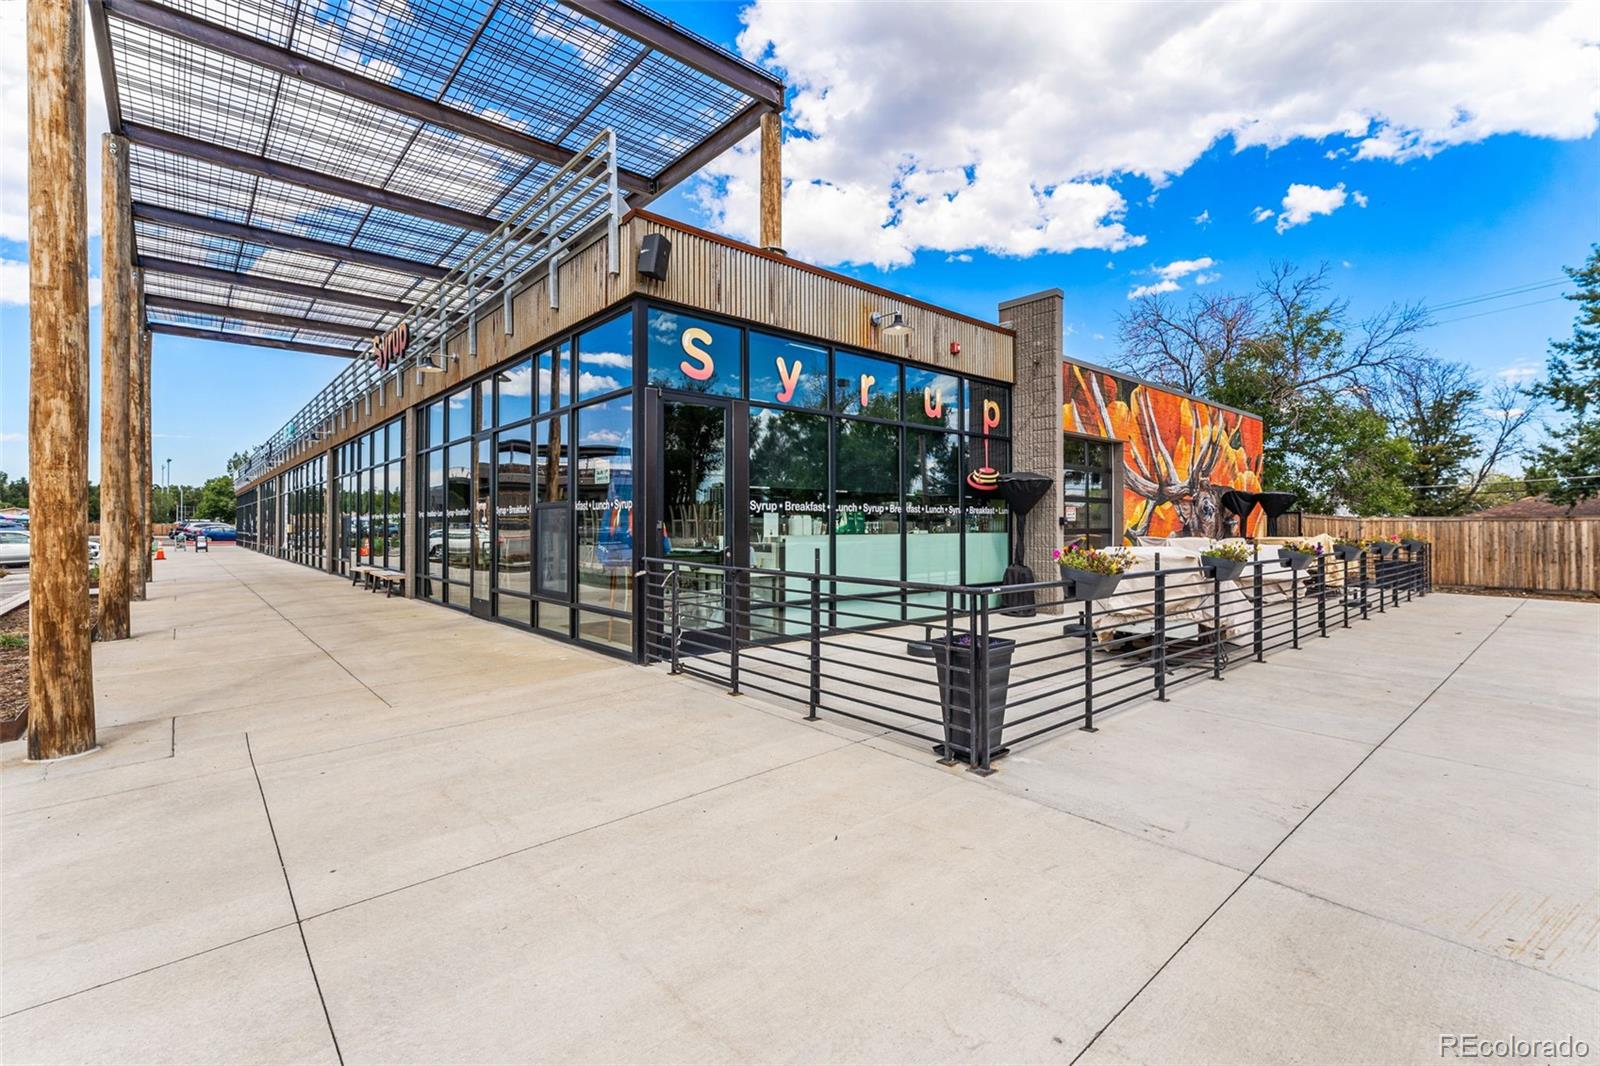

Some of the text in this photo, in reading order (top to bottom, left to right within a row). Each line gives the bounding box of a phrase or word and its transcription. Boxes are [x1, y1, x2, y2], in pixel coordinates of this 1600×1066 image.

[680, 327, 1001, 435] Syrup
[592, 499, 610, 510] Lunch
[614, 499, 633, 511] Syrup
[749, 500, 778, 513] Syrup
[784, 501, 826, 512] Breakfast
[835, 503, 858, 512] unch
[863, 503, 887, 514] Syrup
[925, 504, 945, 514] Lunch
[969, 505, 995, 515] Breakfast
